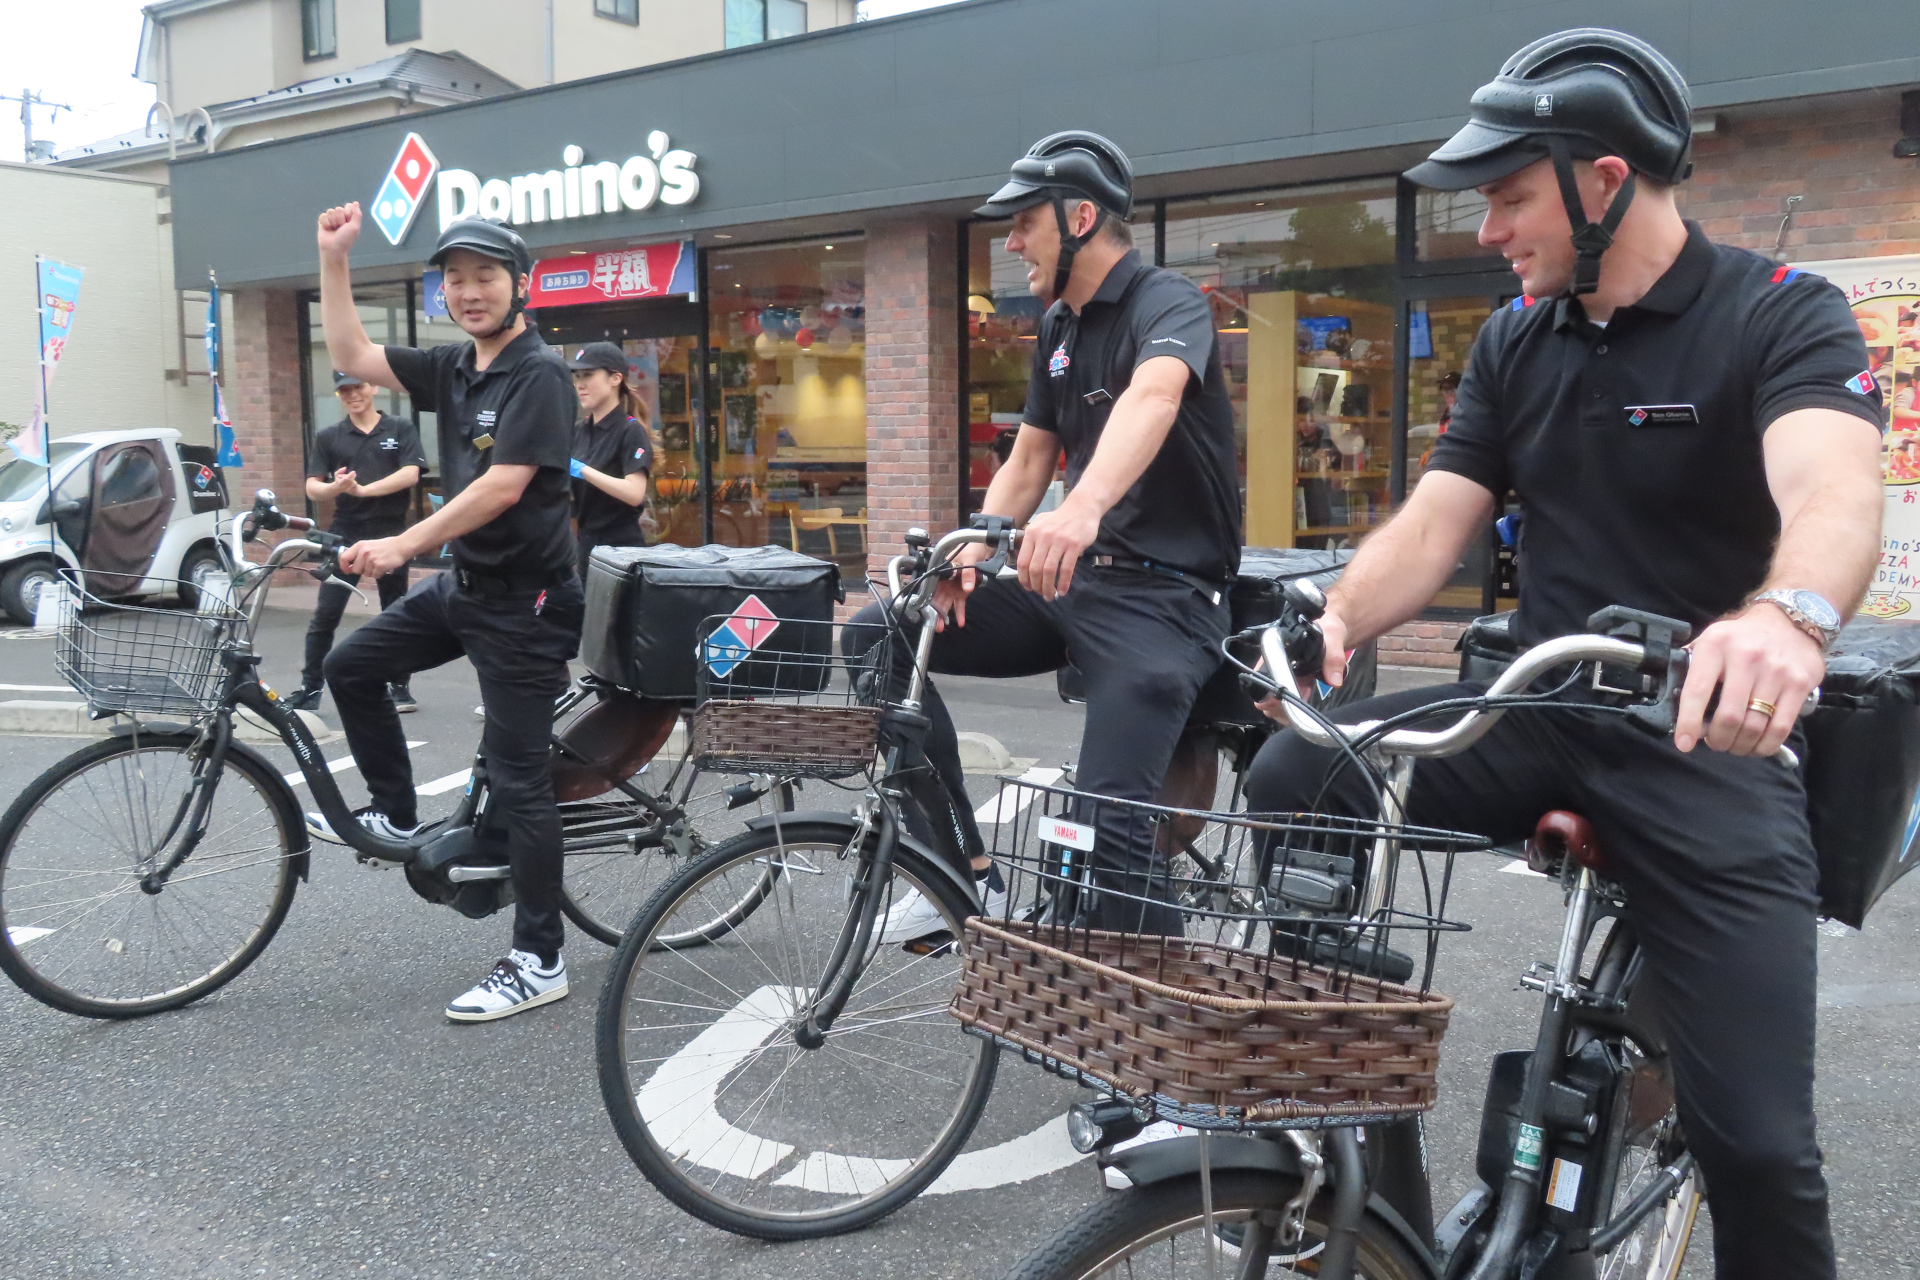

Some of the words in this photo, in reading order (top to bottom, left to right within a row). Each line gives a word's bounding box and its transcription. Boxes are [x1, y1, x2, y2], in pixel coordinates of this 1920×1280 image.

[437, 130, 700, 232] Domino's
[594, 253, 650, 293] 半額
[1845, 276, 1920, 300] んでつくっ
[193, 490, 220, 498] Domino
[1883, 535, 1920, 553] ino's
[1880, 552, 1909, 569] ZZA
[1879, 570, 1920, 589] DEMY
[1054, 824, 1078, 842] YAMAHA
